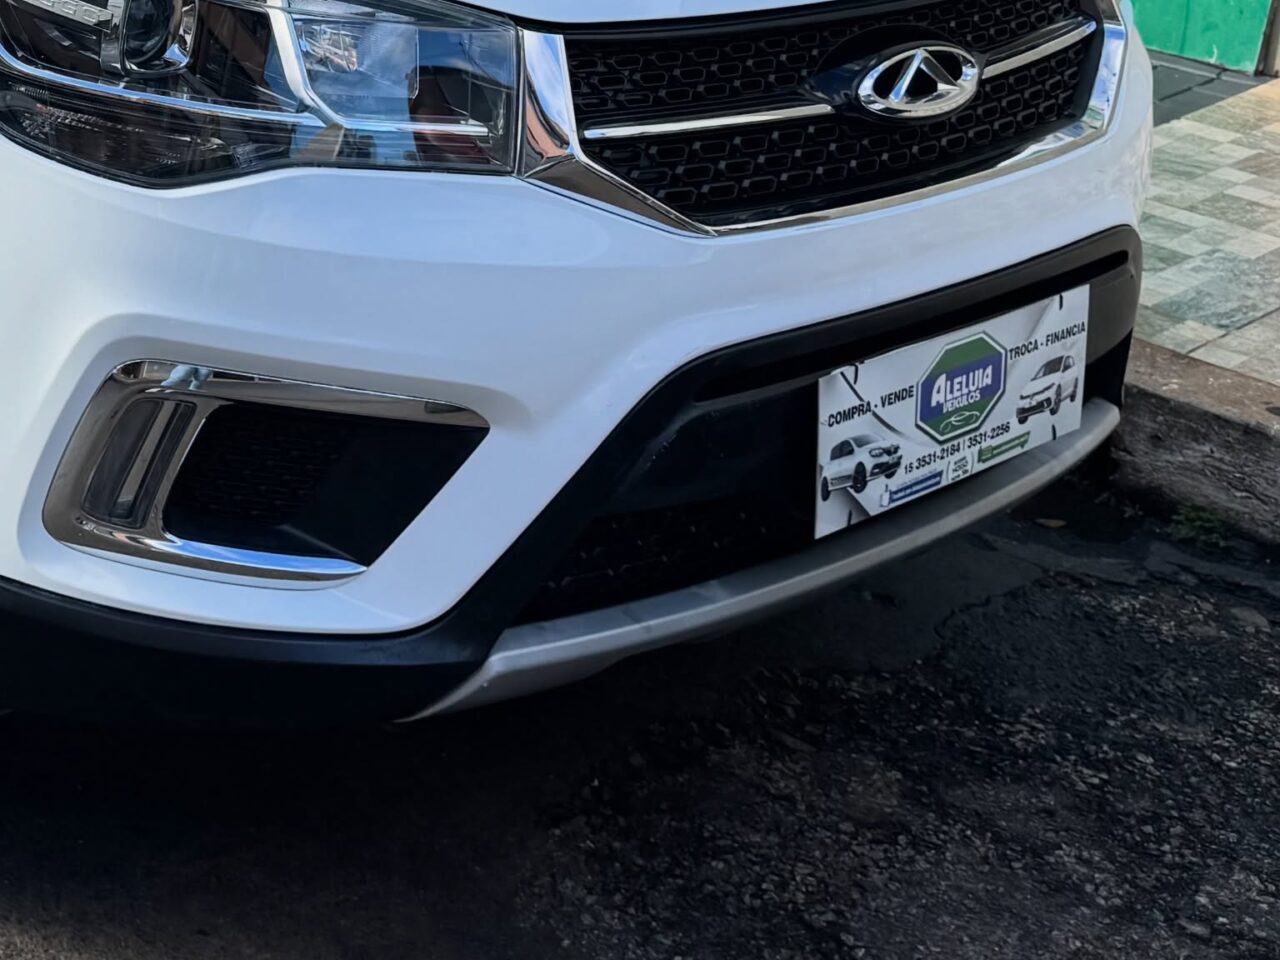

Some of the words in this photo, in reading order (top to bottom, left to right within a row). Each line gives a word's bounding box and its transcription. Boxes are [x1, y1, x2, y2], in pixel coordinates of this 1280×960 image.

[1008, 341, 1039, 361] TROCA
[1045, 321, 1086, 347] FINANCIA
[827, 400, 872, 428] COMPRA
[880, 385, 915, 409] VENDE
[930, 365, 993, 407] ALELUIA
[915, 441, 961, 470] 3531-2184
[967, 422, 1011, 449] 3531-2256
